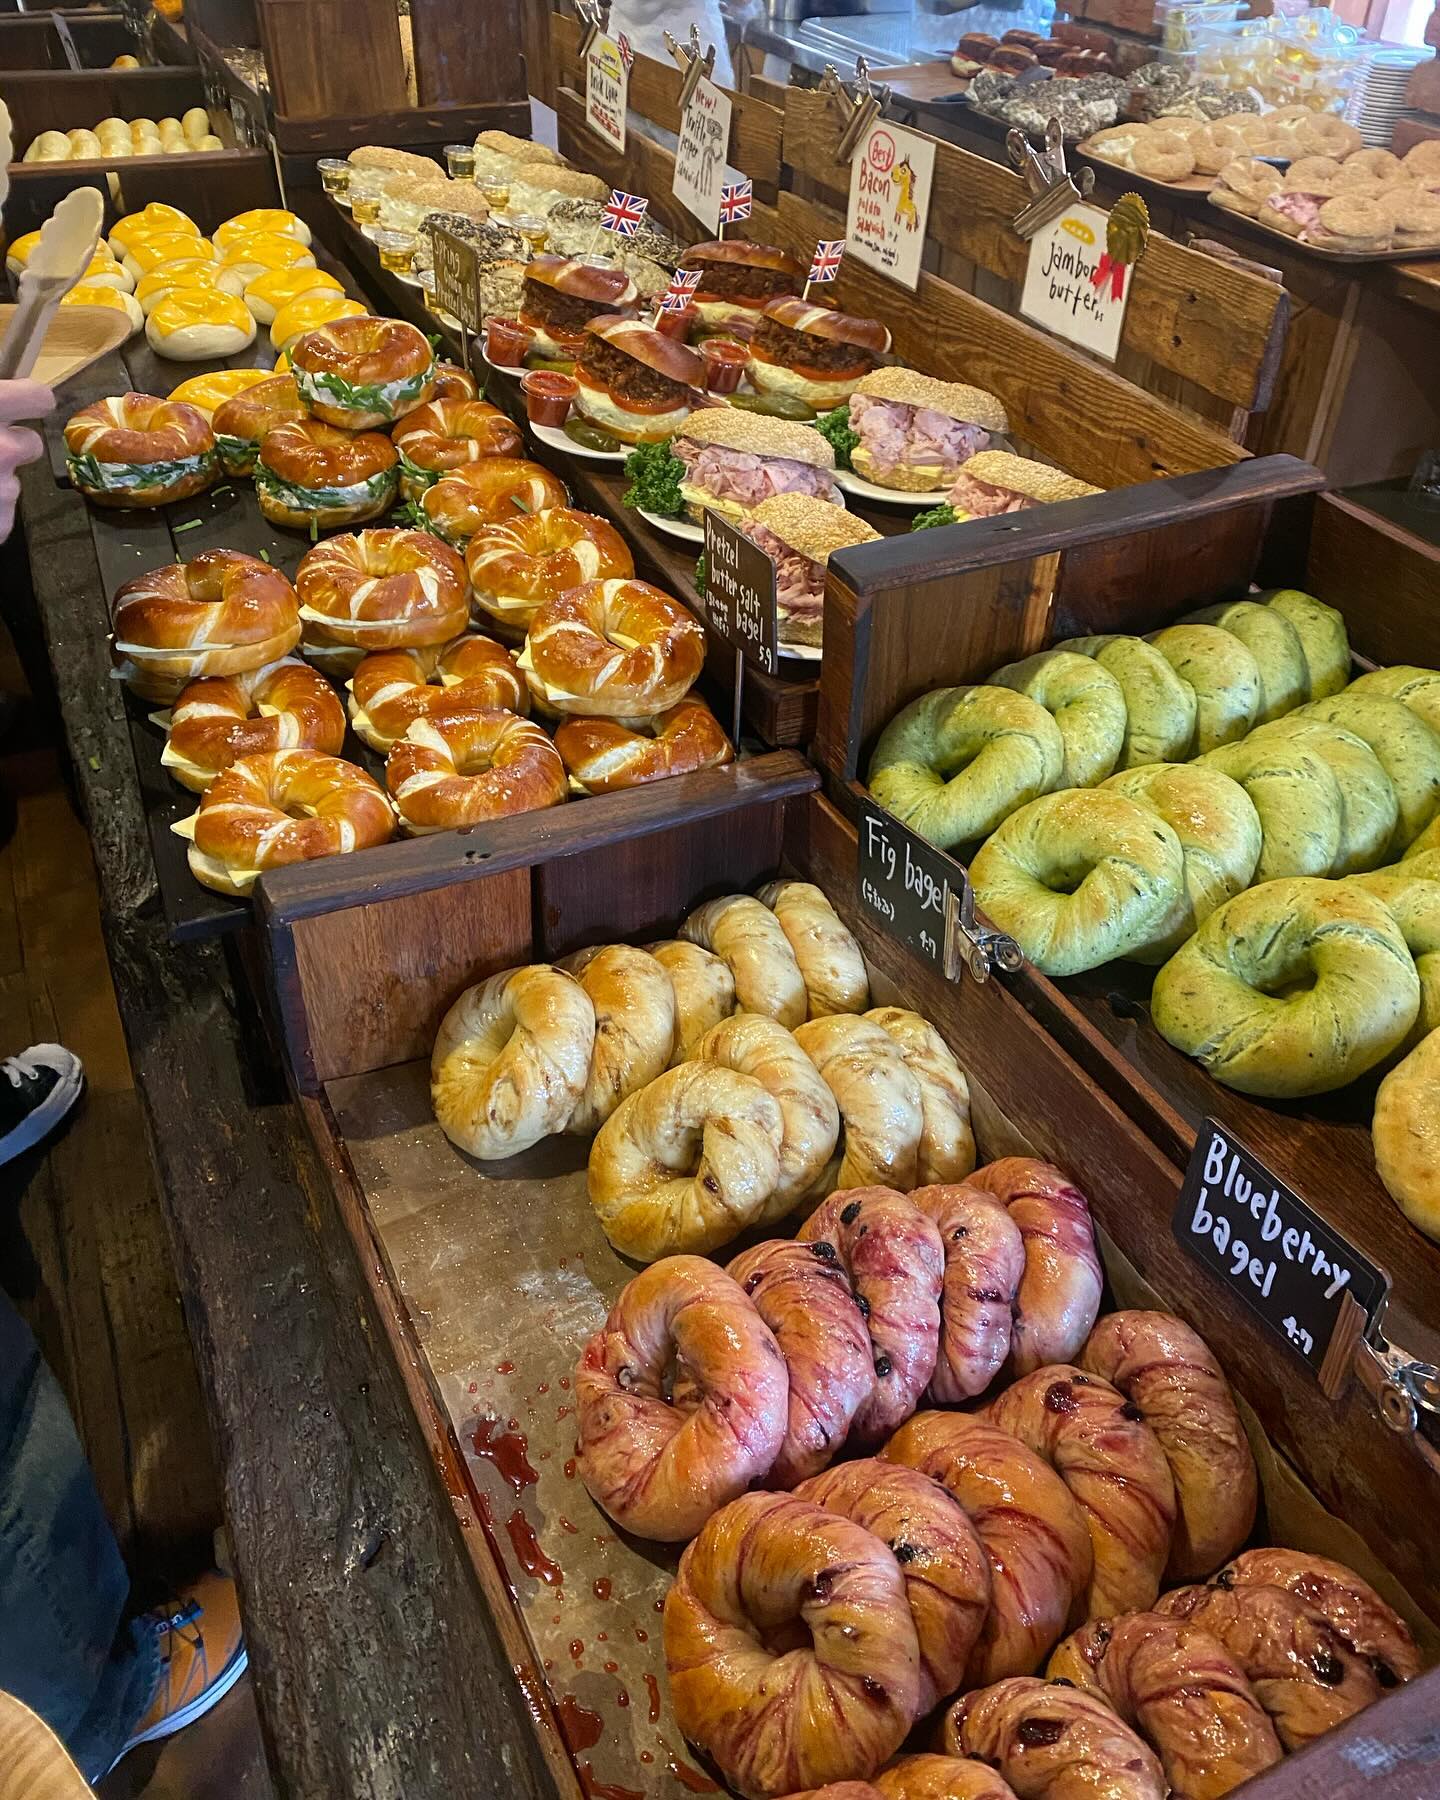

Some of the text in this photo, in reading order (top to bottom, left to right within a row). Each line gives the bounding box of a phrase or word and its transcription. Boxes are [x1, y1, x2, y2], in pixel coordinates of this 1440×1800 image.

[695, 87, 717, 113] New!
[684, 104, 707, 146] Truffle
[679, 134, 699, 161] pepper
[872, 140, 892, 167] Best
[858, 156, 891, 203] Bacon
[856, 196, 882, 217] potato
[434, 231, 460, 278] Spring
[1048, 277, 1099, 316] butter
[706, 515, 739, 570] Pretzel
[711, 553, 738, 597] butter
[740, 584, 761, 619] salt
[736, 599, 764, 643] bagel
[759, 646, 772, 675] 5.9
[865, 815, 948, 918] Fig bagel
[919, 929, 937, 960] 4.7
[1203, 1132, 1352, 1300] Blueberry
[1191, 1187, 1278, 1298] bagel
